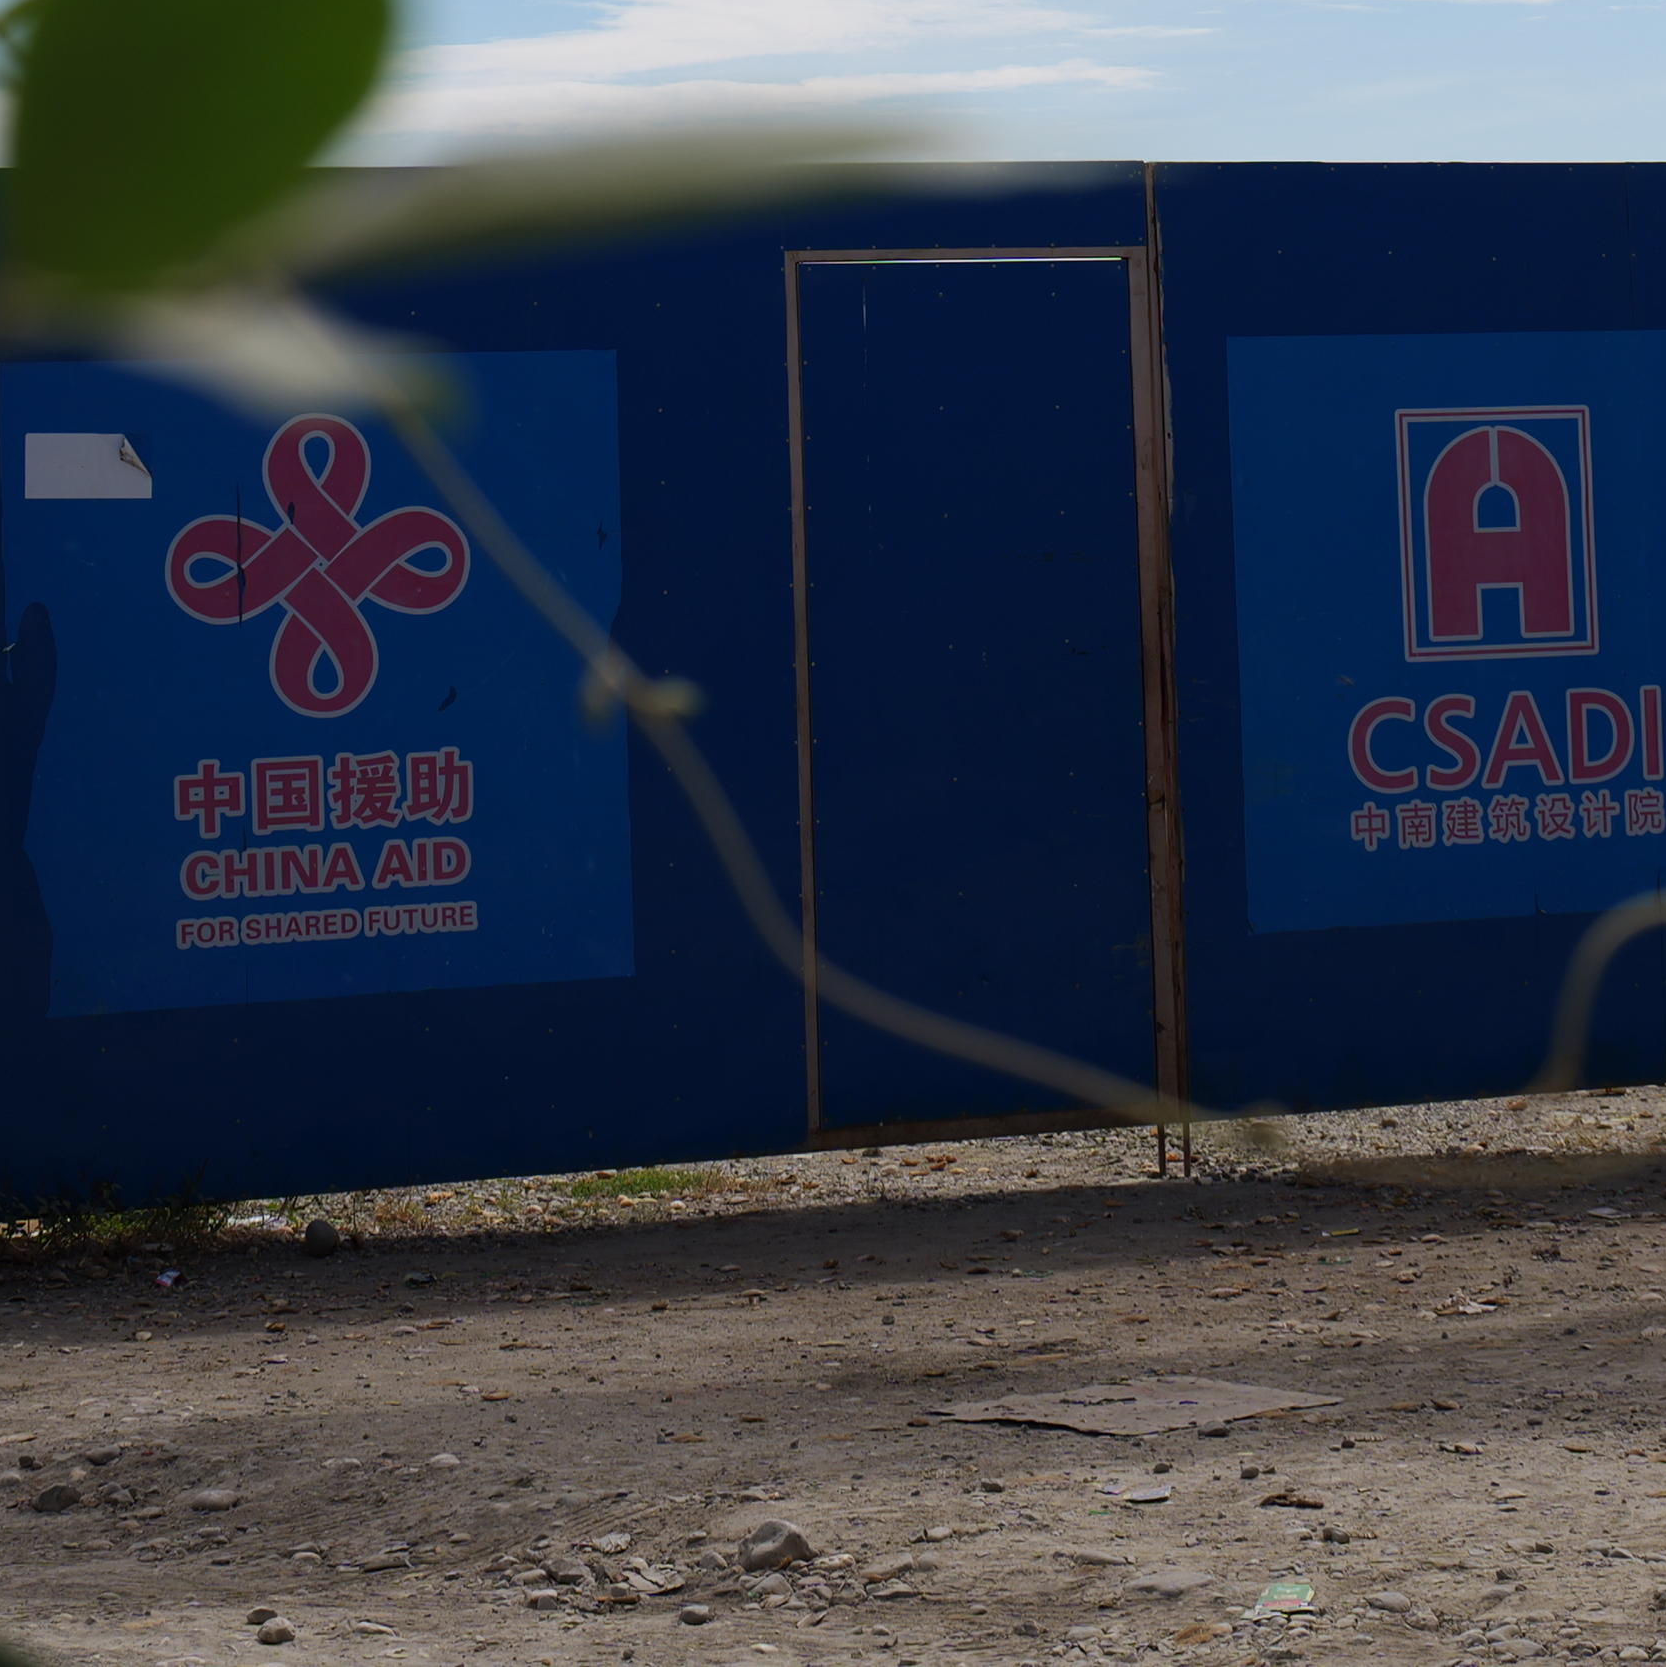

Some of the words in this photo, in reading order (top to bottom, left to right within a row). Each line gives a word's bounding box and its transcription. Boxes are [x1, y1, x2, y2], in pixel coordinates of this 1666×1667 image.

[1347, 684, 1665, 793] CSADI
[174, 746, 474, 839] 中国援助
[1350, 788, 1666, 852] 中南建筑设计院
[181, 842, 365, 901] CHINA
[372, 836, 472, 889] AID
[176, 917, 239, 949] FOR
[241, 908, 362, 947] SHARED
[363, 901, 478, 937] FUTURE
